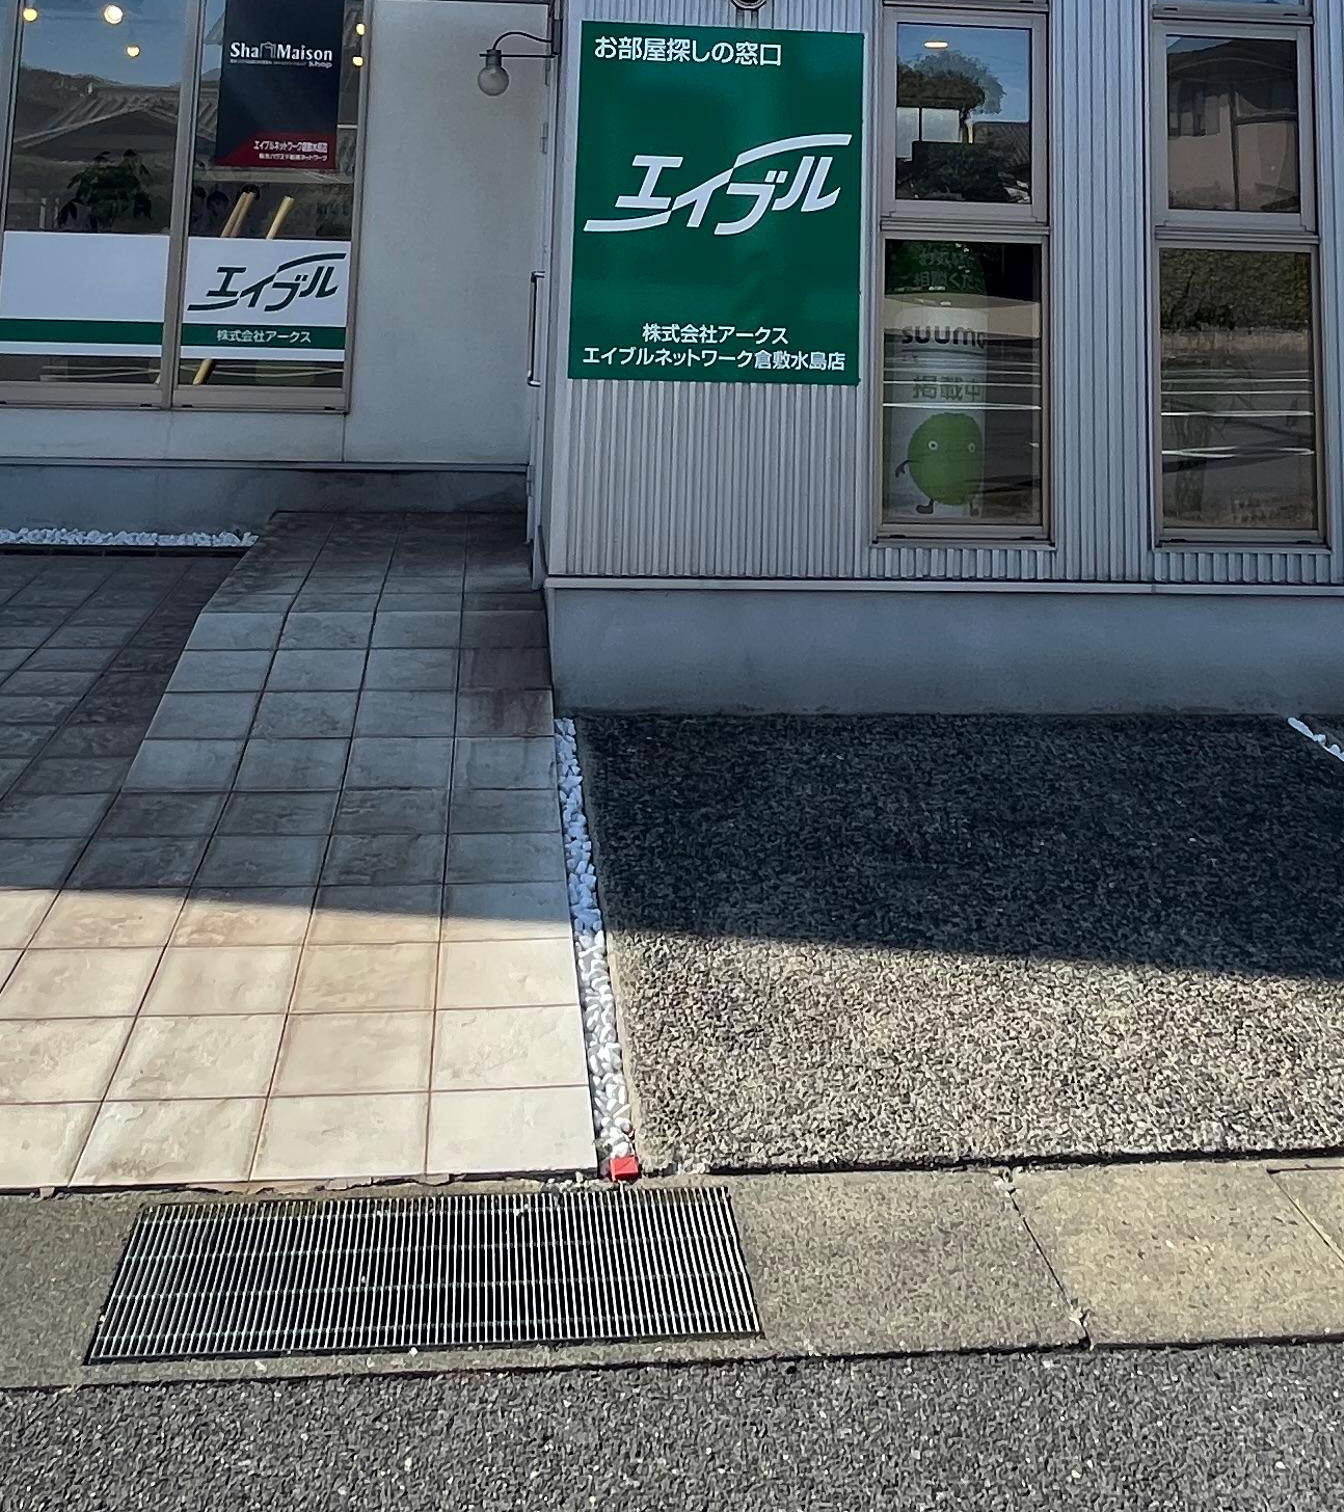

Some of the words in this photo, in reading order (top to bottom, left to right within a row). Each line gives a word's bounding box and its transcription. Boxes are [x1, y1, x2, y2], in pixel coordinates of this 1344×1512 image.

[230, 41, 260, 59] Sha
[276, 44, 333, 62] Maison
[594, 36, 782, 67] お部屋探しの窓口
[583, 133, 853, 236] エイブル
[187, 253, 346, 312] エイブル
[217, 329, 311, 343] 株式会社アークス
[642, 323, 789, 345] 株式会社アークス
[582, 347, 846, 371] エイブルネットワーク倉敷水島店
